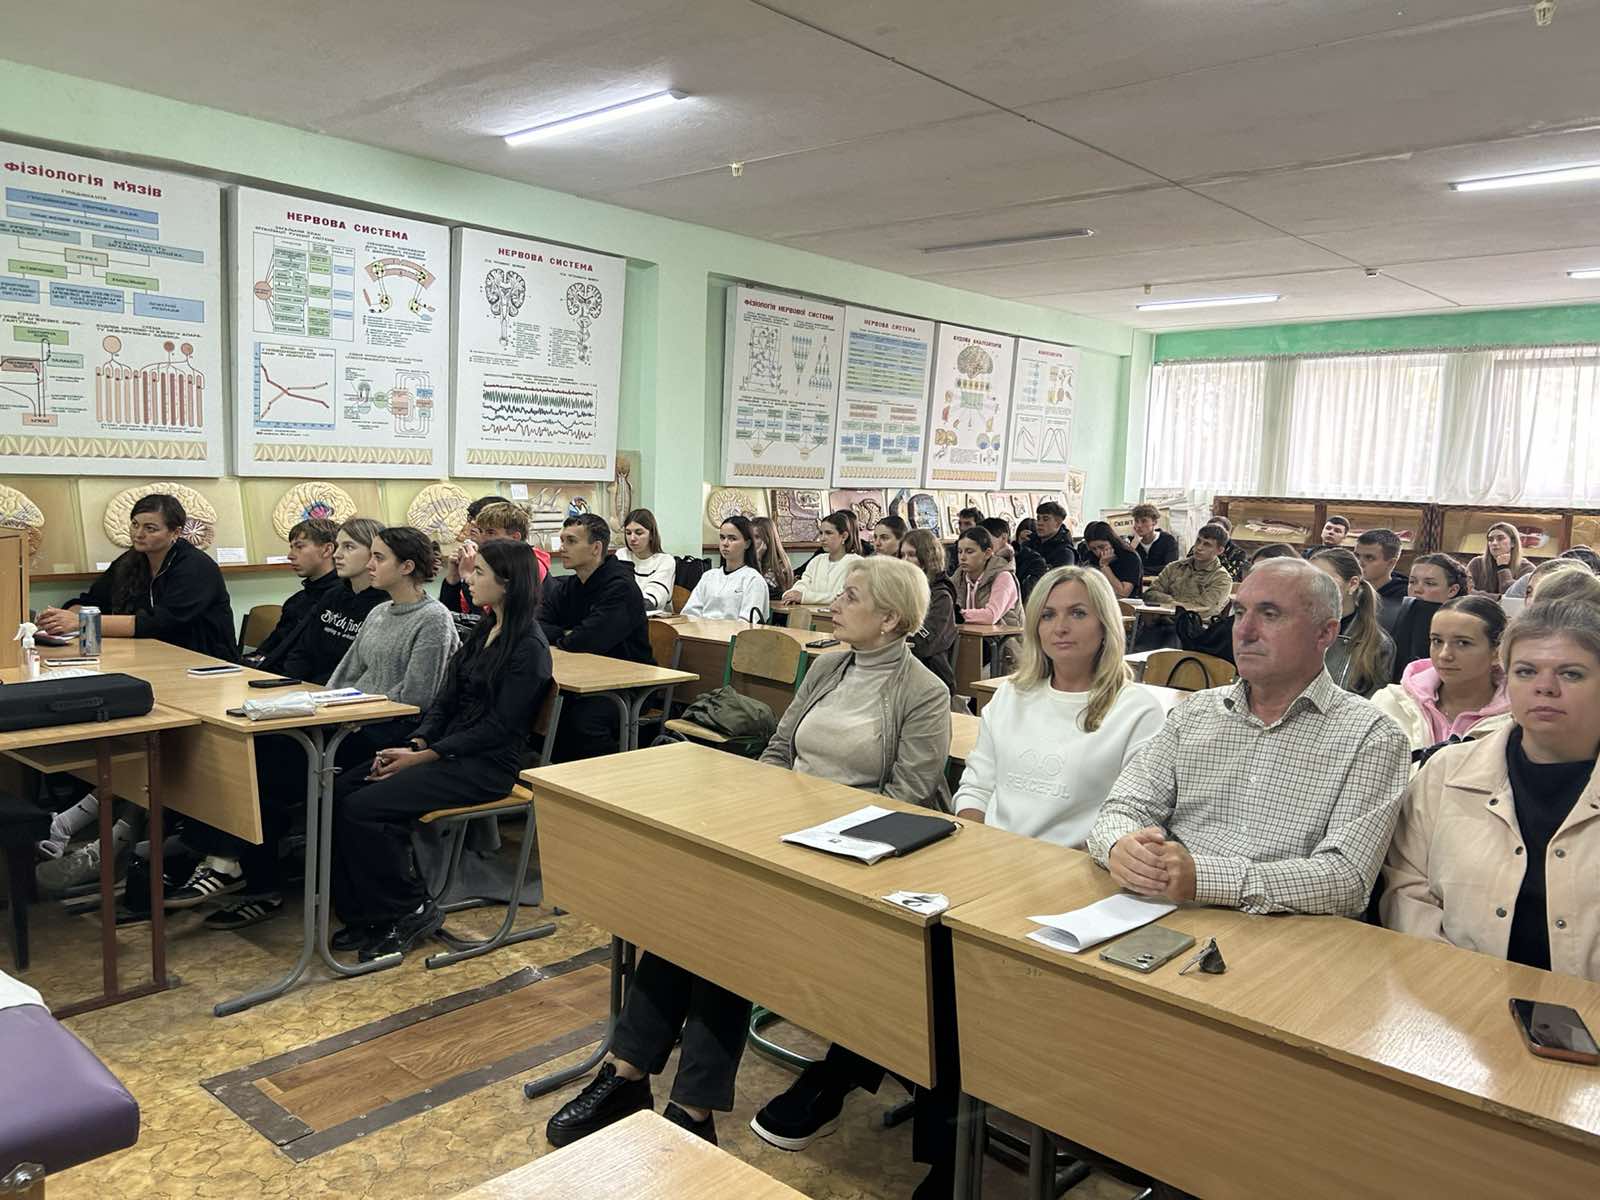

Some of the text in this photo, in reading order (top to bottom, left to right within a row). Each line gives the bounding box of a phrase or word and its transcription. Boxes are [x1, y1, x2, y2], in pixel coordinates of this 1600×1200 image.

[287, 211, 346, 229] НЕРВОВА
[354, 224, 408, 240] СИСТЕМА
[498, 247, 593, 272] НЕРВОВА СИСТЕМА
[744, 299, 834, 321] ФІЗІОЛОГІЯ НЕРВОВОЇ СИСТЕМИ
[864, 319, 889, 328] НЕРВОВА
